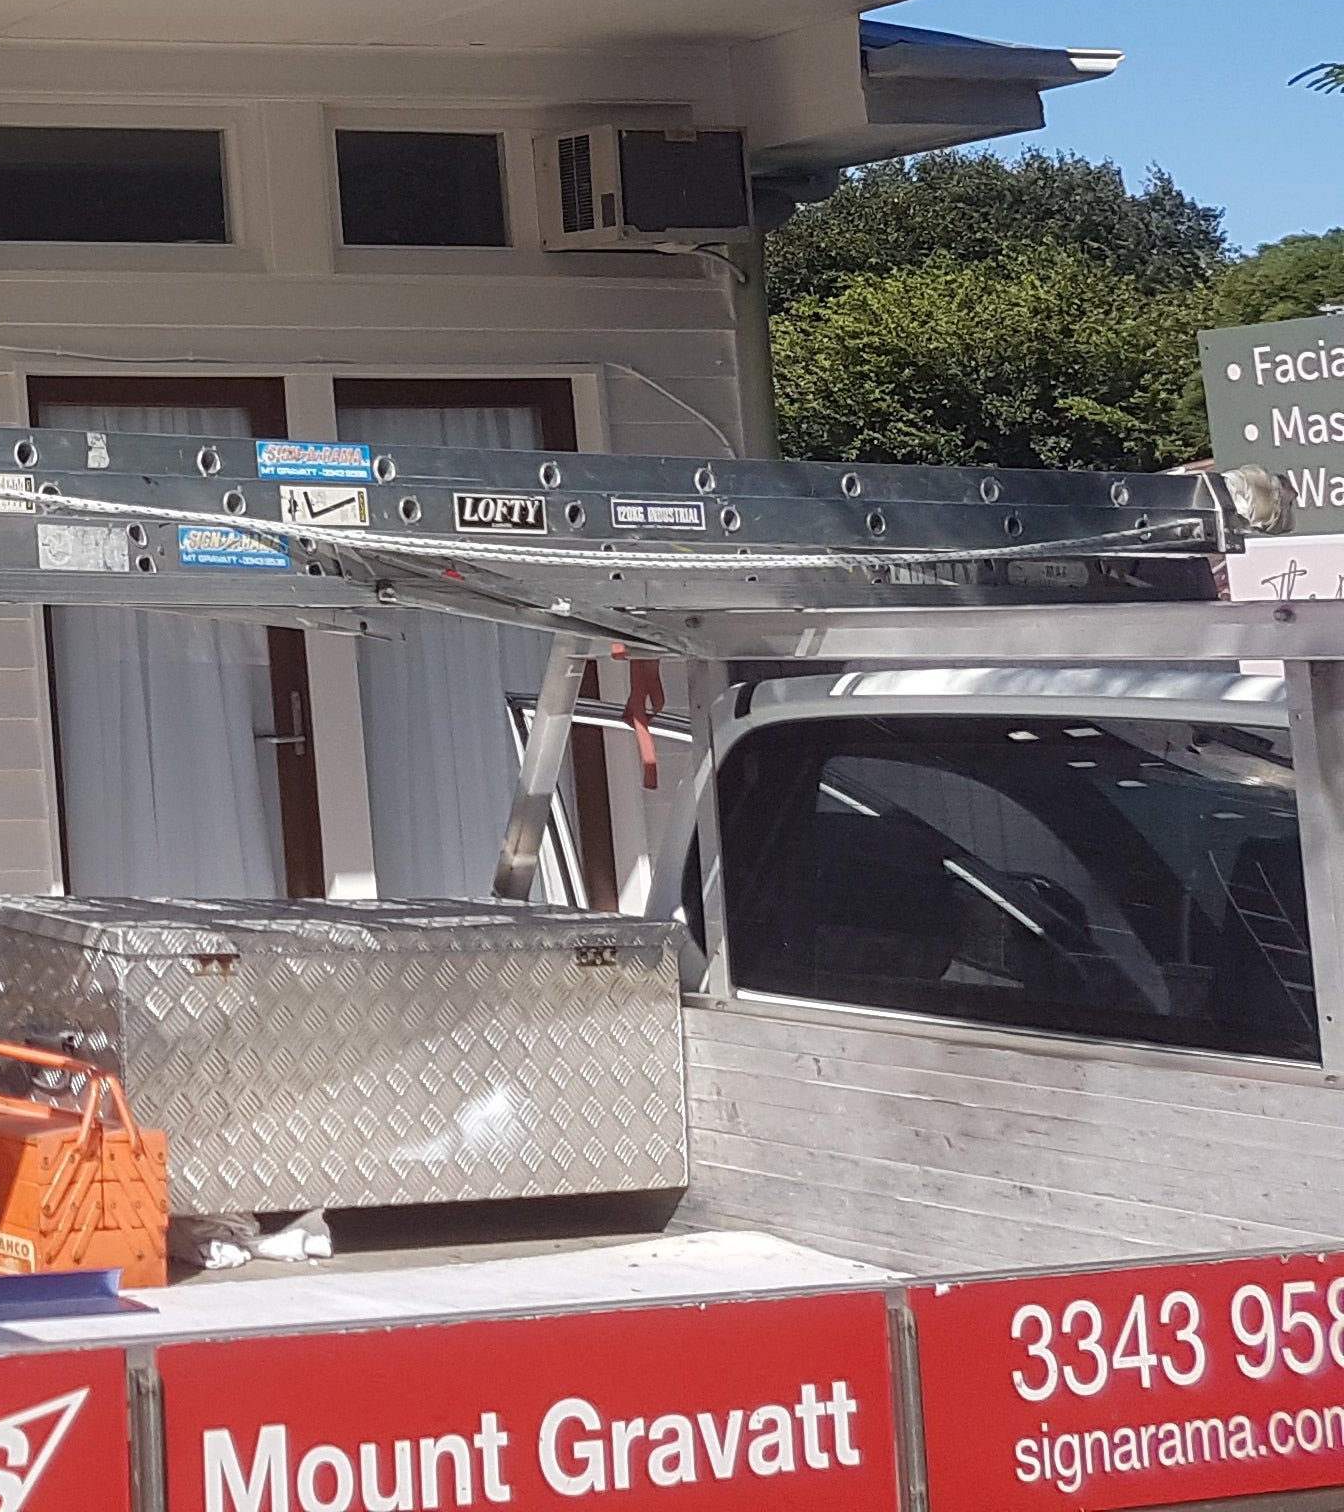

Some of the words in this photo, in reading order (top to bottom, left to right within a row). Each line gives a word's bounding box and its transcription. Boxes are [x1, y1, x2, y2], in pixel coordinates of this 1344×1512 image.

[1271, 405, 1344, 448] Mas
[1287, 467, 1344, 509] Wa
[462, 497, 541, 524] LOFTY
[647, 507, 700, 524] INDUSTRIAL
[1010, 1290, 1207, 1402] 3343
[203, 1411, 511, 1512] Mount
[536, 1380, 861, 1498] Gravatt
